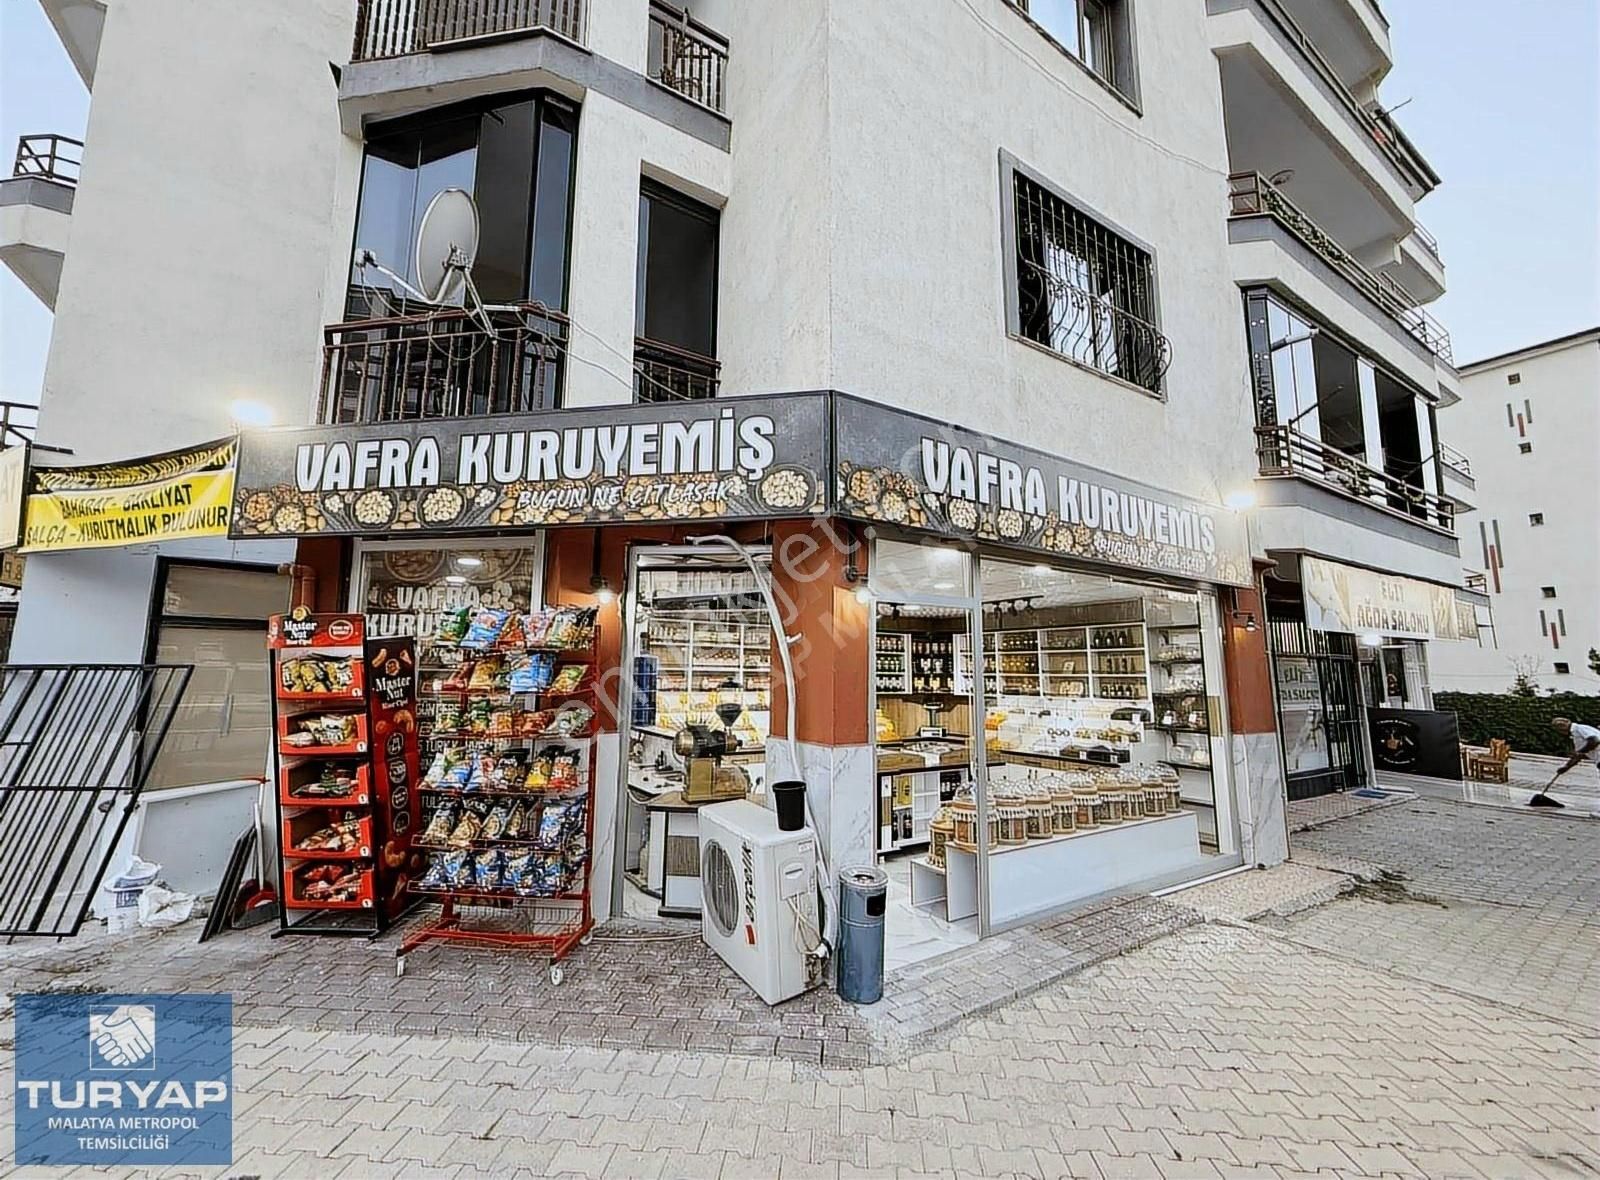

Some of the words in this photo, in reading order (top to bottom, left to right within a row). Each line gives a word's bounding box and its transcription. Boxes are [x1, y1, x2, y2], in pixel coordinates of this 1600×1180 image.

[296, 437, 441, 492] VAFRA
[457, 407, 775, 481] KURUYEMİŞ
[592, 482, 622, 504] NE
[920, 437, 1047, 516] VAFRA
[1058, 474, 1215, 555] KURUYEMİŞ
